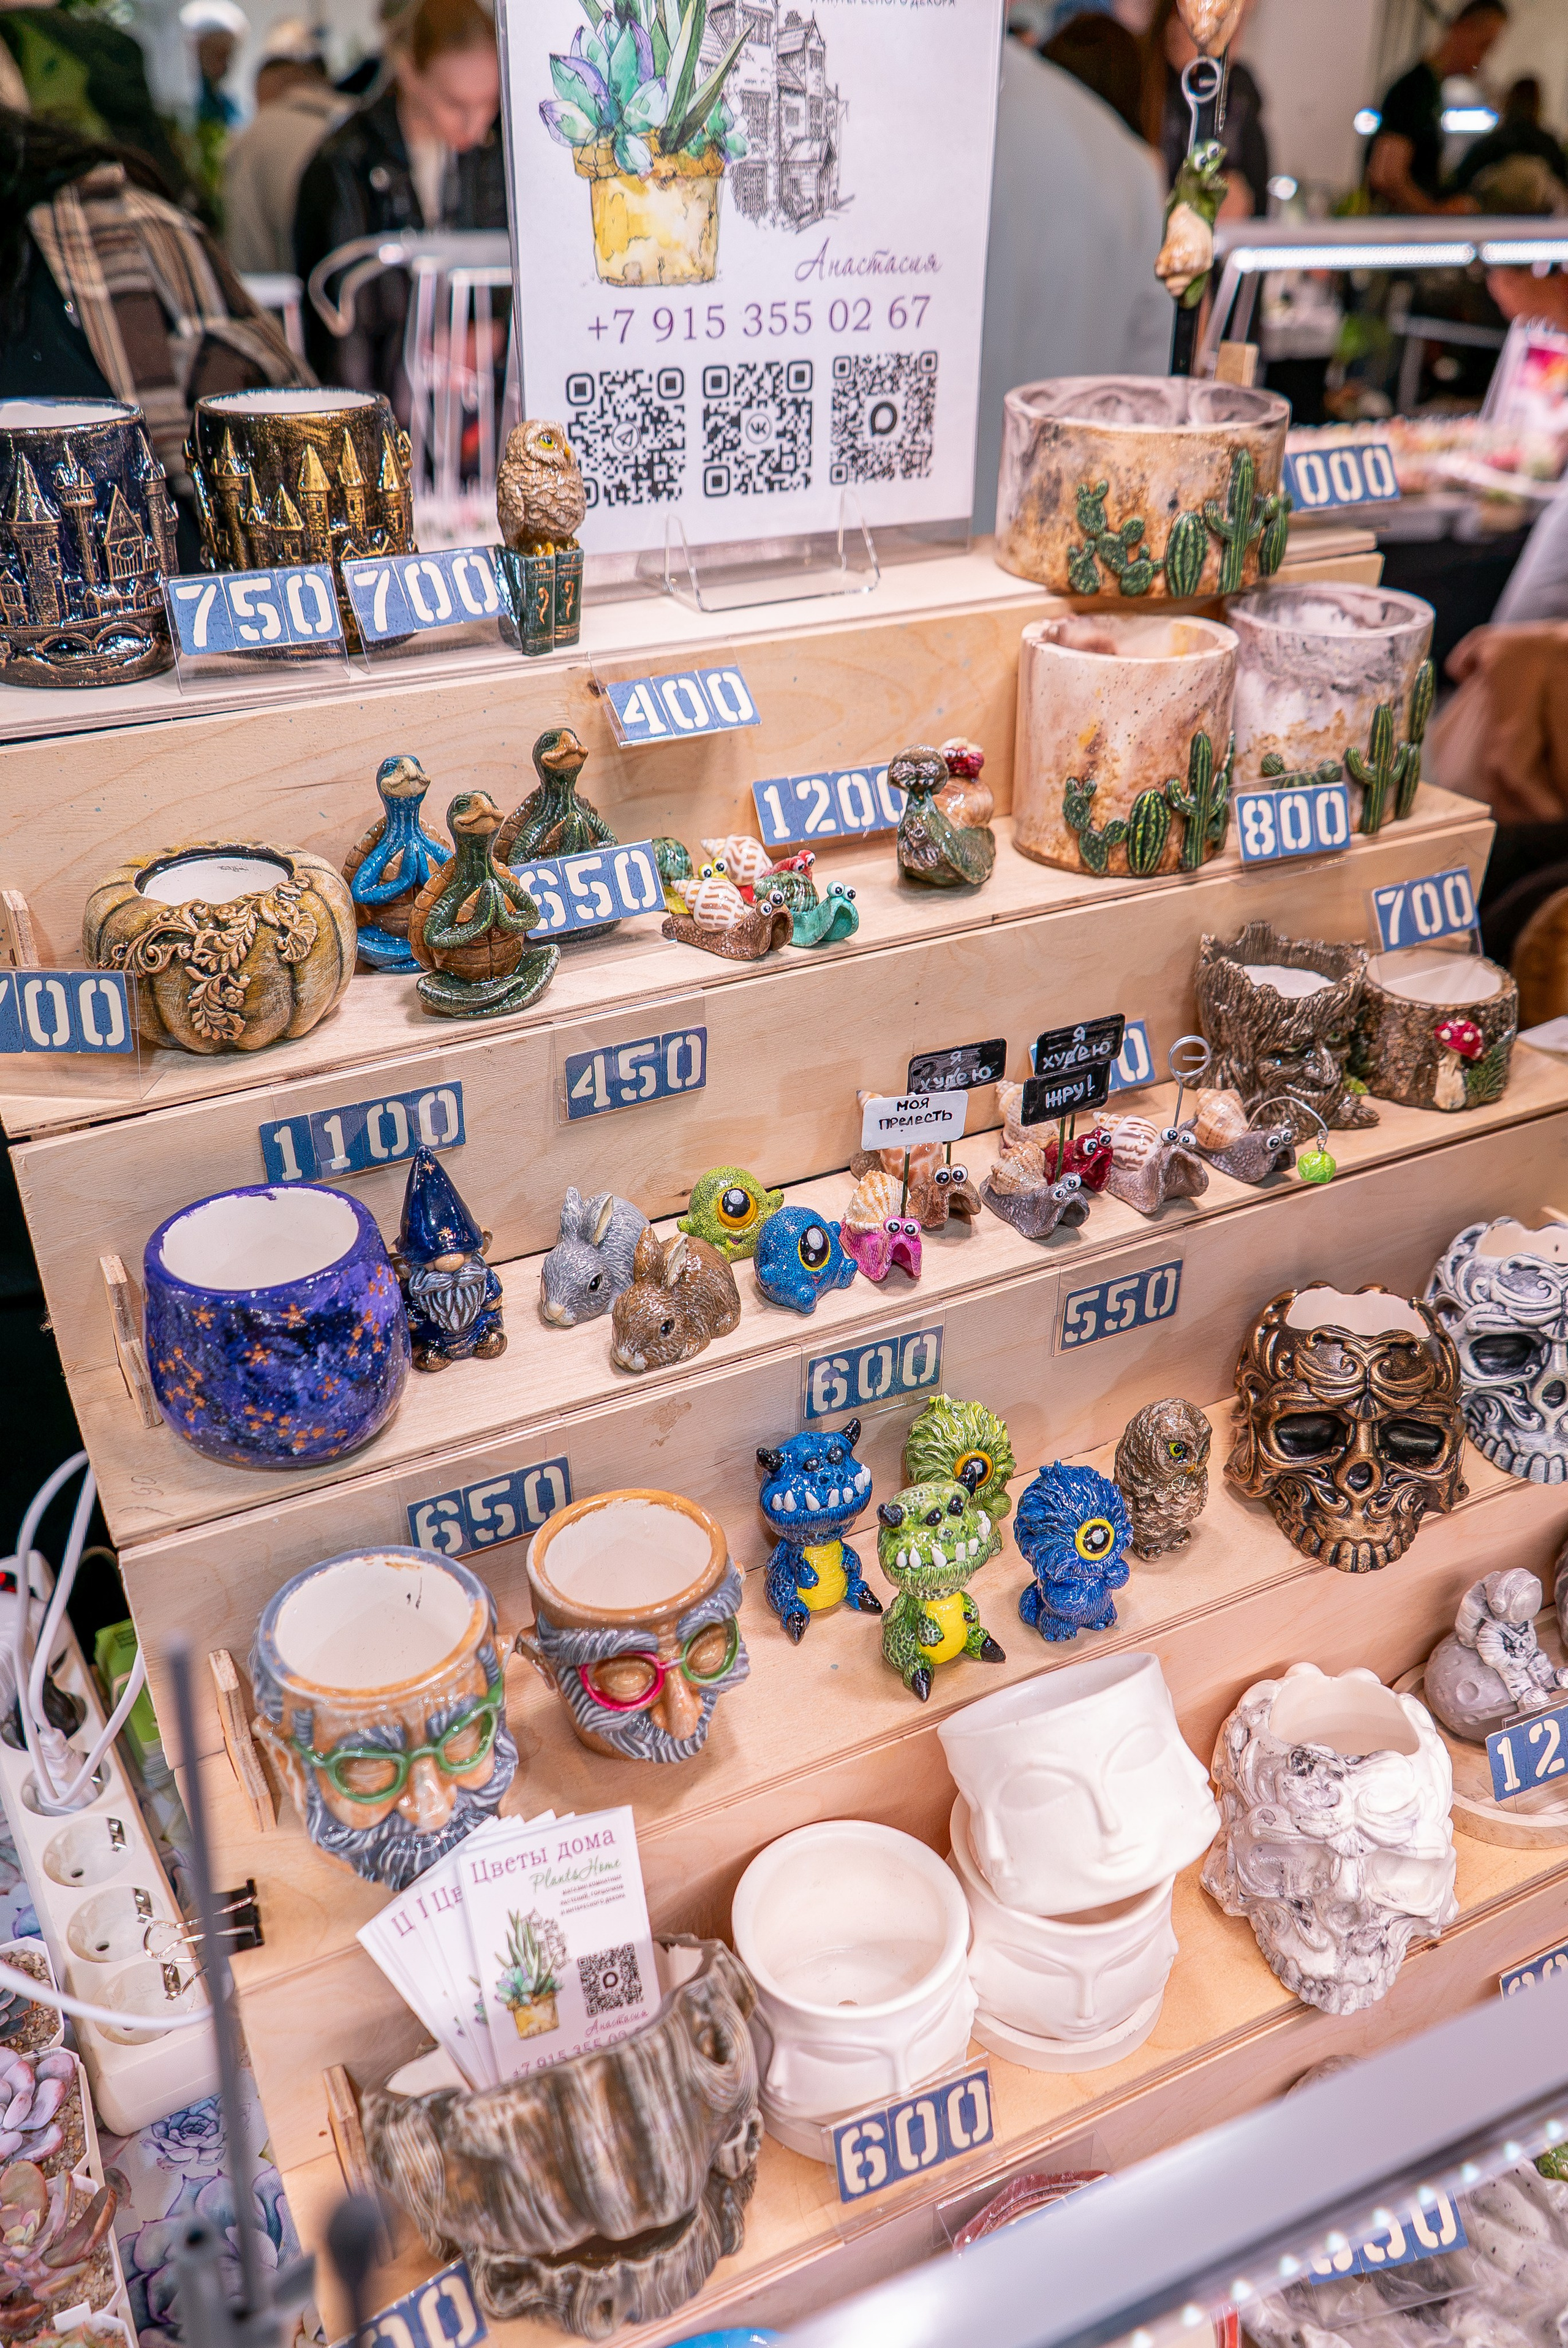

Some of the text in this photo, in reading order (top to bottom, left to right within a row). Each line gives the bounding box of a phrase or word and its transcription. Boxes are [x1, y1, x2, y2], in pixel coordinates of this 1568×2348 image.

[795, 237, 941, 281] Анастасия
[588, 295, 932, 344] +7 915 355 02 67
[175, 573, 334, 647] 750
[353, 555, 499, 633] 700
[623, 671, 754, 734] 400
[1242, 791, 1346, 856] 800
[519, 850, 657, 930] 650
[1378, 874, 1474, 945] 700
[0, 979, 125, 1046] 00
[571, 1033, 703, 1108] 450
[274, 1089, 458, 1181] 1100
[1064, 1267, 1177, 1343] 550
[813, 1334, 938, 1412] 600
[416, 1466, 567, 1554] 650
[470, 1829, 616, 1886] Цветы дома
[841, 2079, 989, 2194] 600
